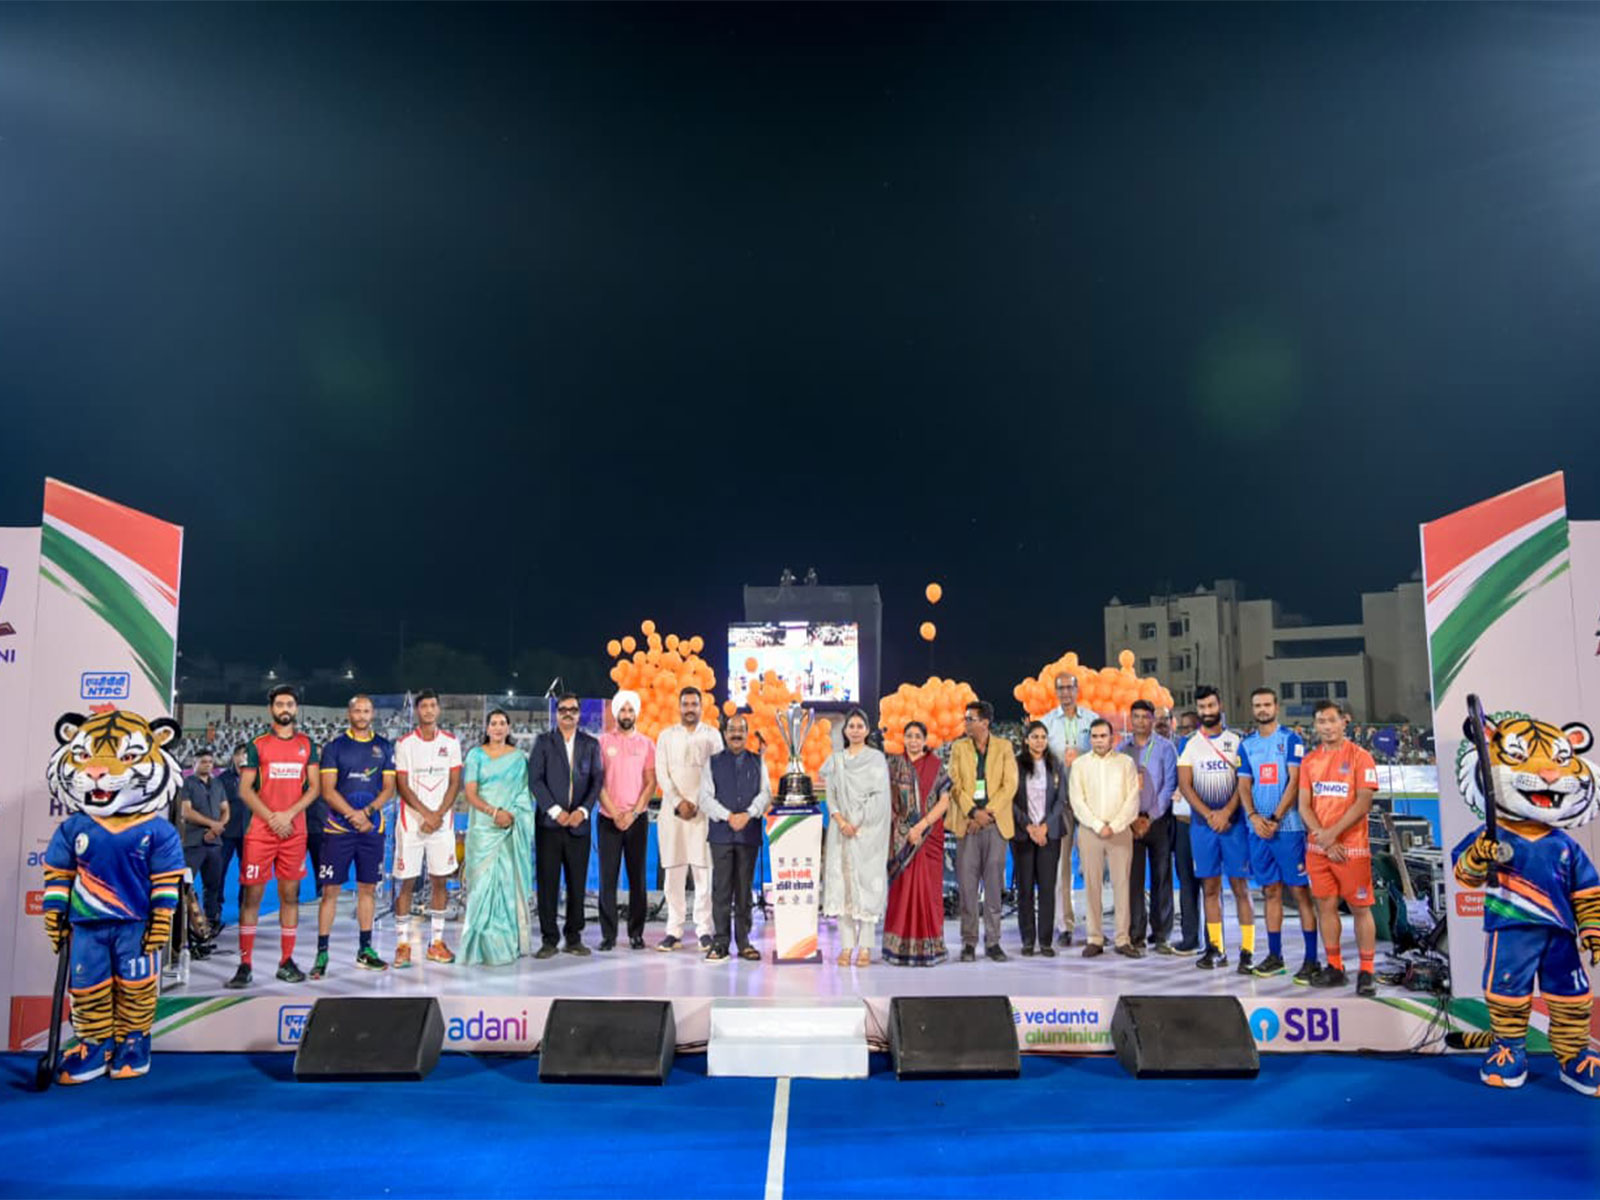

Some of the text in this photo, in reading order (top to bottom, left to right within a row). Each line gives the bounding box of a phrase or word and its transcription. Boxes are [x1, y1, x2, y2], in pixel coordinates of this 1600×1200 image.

[87, 687, 122, 696] NTPC
[1206, 760, 1229, 770] SECL
[246, 864, 260, 879] 21
[319, 864, 334, 879] 24
[128, 956, 146, 977] 11
[1024, 1008, 1099, 1024] vedanta
[447, 1010, 527, 1041] adani
[1284, 1007, 1340, 1042] SBI
[1024, 1027, 1113, 1044] aluminium
